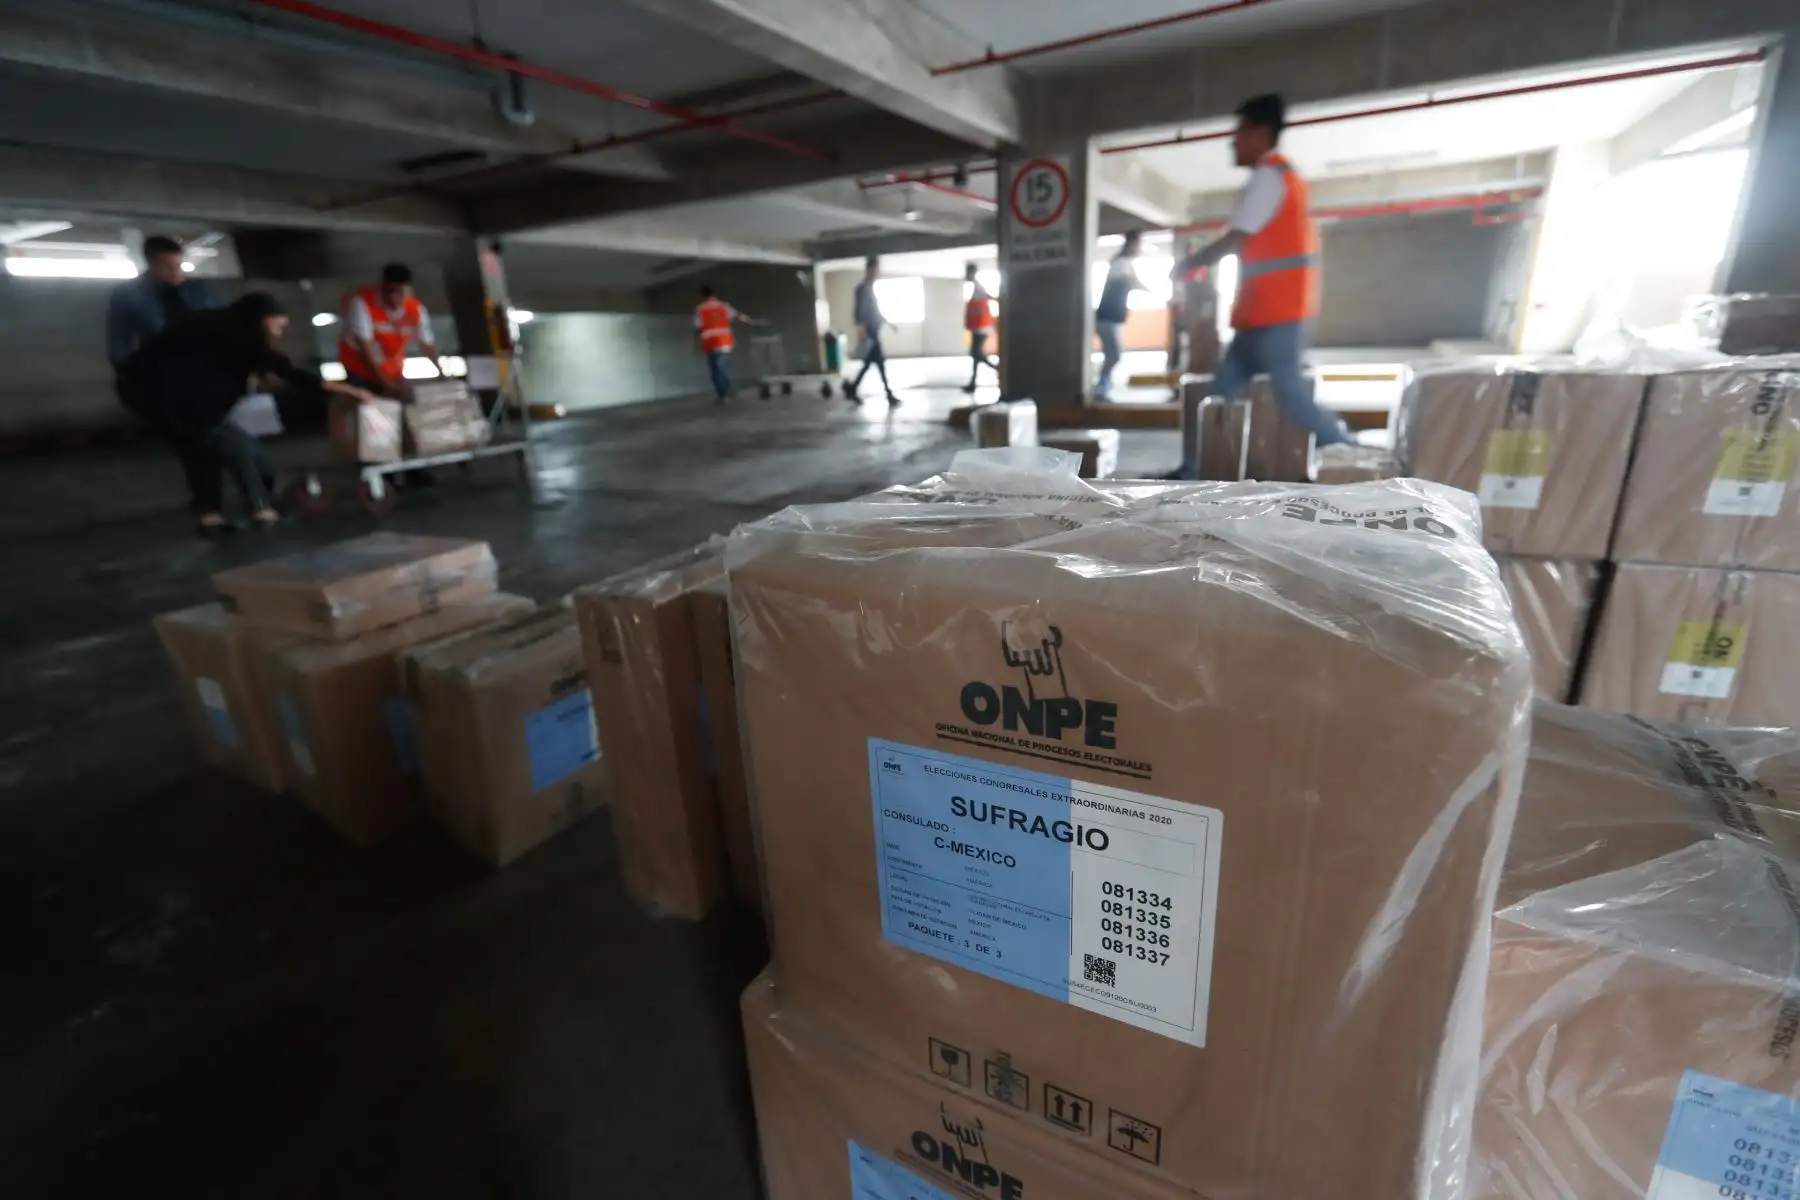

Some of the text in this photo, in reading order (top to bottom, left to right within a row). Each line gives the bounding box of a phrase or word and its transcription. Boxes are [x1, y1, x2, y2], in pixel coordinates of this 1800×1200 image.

[1026, 172, 1053, 204] 15
[960, 681, 1118, 750] ONPE
[935, 722, 1152, 772] OFICINA NACIONAL DE PROCESOS ELECTORALES
[923, 764, 1173, 825] ELECCIONES CONGRESALES EXTRAORDINARIAS 2020
[883, 807, 949, 833] CONSULADO
[949, 793, 1110, 853] SUFRAGIO
[933, 835, 1016, 869] C-MEXICO
[1101, 879, 1173, 912] 081334
[1100, 897, 1172, 930] 081335
[907, 920, 955, 944] PAQUETE
[962, 938, 970, 949] 3
[974, 942, 990, 955] DE
[995, 949, 1003, 959] 3
[1100, 916, 1171, 949] 081336
[1101, 934, 1170, 968] 081337
[911, 1130, 1024, 1200] ONPE
